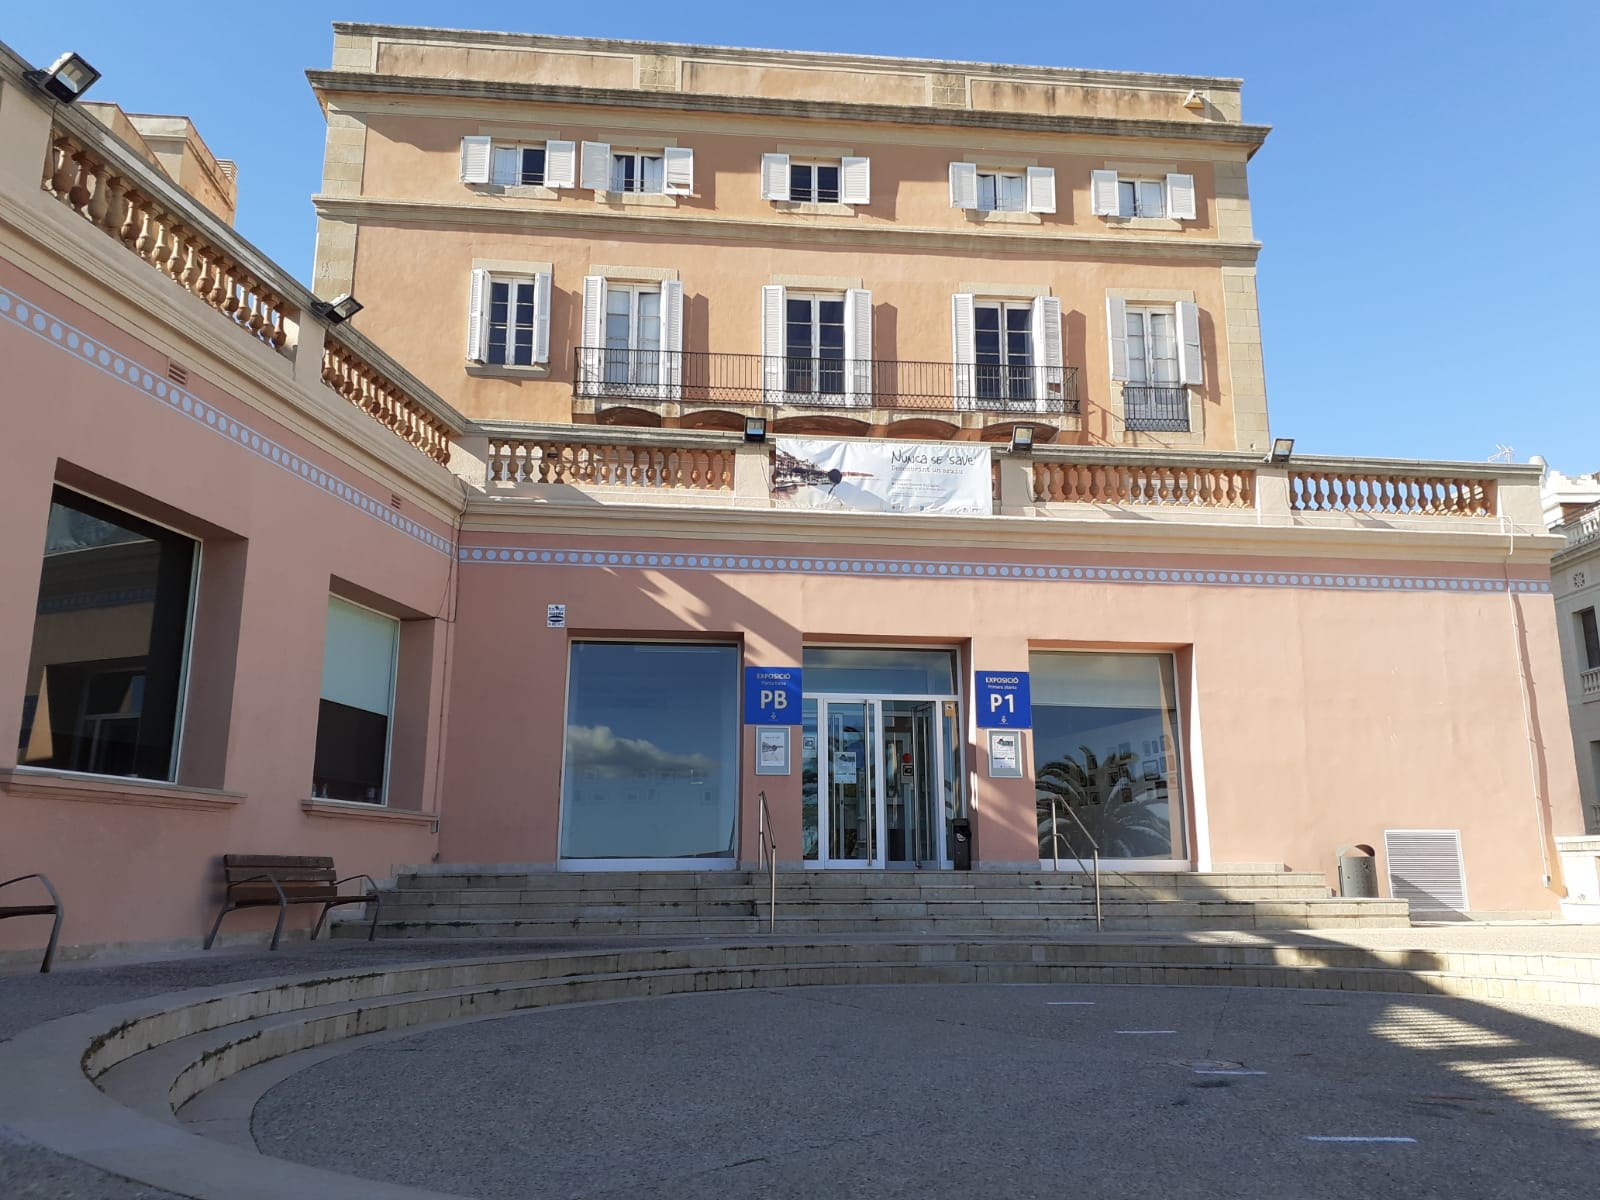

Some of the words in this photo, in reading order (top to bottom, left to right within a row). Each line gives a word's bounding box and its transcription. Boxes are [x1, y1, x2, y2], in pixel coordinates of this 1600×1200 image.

[756, 672, 791, 680] EXPOSICIÓ
[985, 676, 1019, 684] EXPOSICIÓ
[760, 689, 788, 710] PB
[990, 693, 1014, 713] P1
